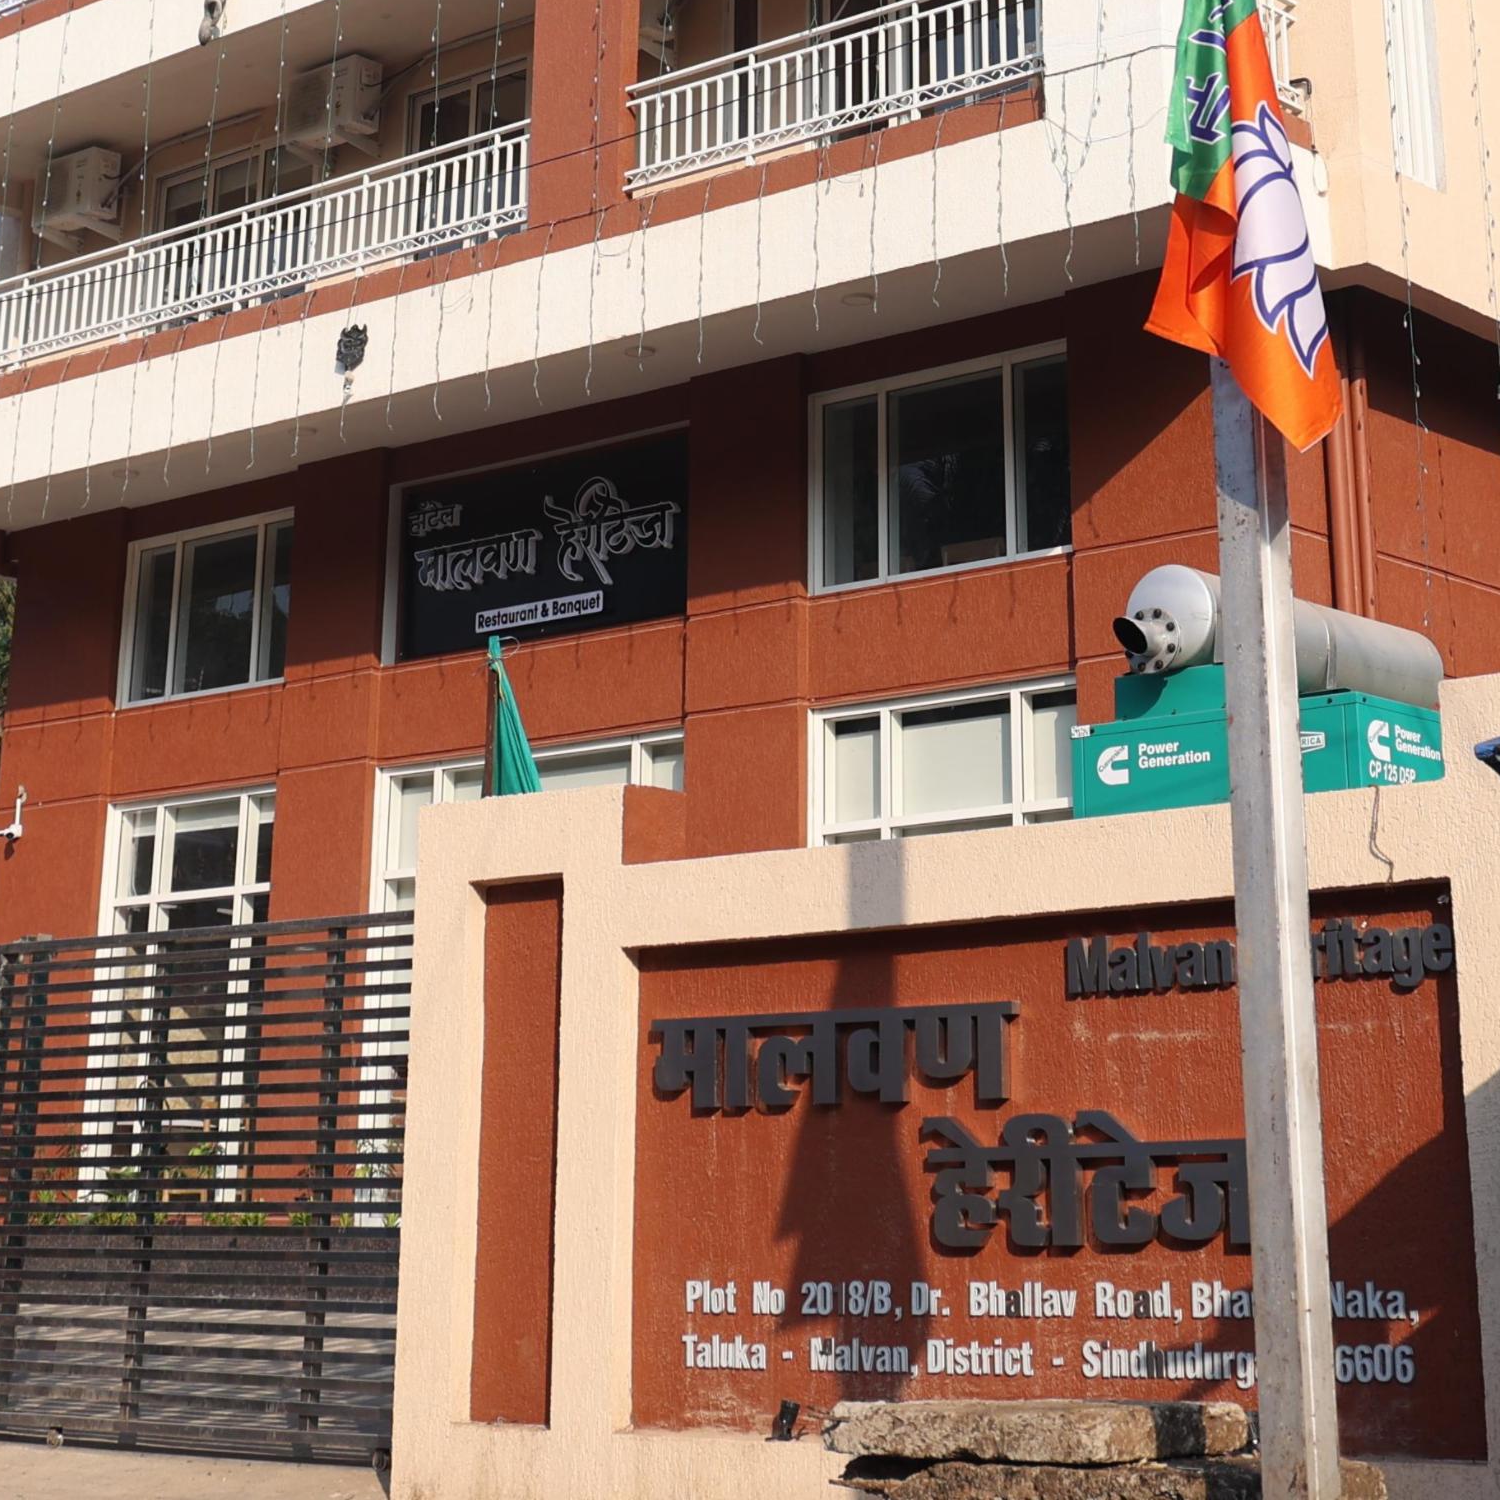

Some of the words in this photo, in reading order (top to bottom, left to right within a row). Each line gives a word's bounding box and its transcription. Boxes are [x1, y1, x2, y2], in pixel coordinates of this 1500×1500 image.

[414, 528, 544, 591] मालवण
[477, 604, 539, 630] Restaurant
[540, 602, 550, 618] &
[552, 593, 601, 619] Banquet
[1138, 741, 1180, 756] Power
[1301, 737, 1322, 746] RICA
[1394, 724, 1421, 743] Power
[1395, 738, 1442, 762] Generation
[1138, 750, 1211, 769] Generation
[1369, 759, 1382, 779] CP
[1383, 763, 1398, 782] 125
[1065, 931, 1236, 1000] Malvan
[1310, 917, 1454, 992] ritage
[648, 1001, 1021, 1114] मालवण
[919, 1109, 1251, 1254] हेरीटेज
[685, 1279, 737, 1316] Plot
[752, 1279, 785, 1316] No
[911, 1281, 950, 1317] Dr.
[969, 1280, 1077, 1318] Bhallav
[1095, 1280, 1183, 1325] Road,
[1191, 1280, 1256, 1319] Bha
[1330, 1280, 1419, 1326] Naka,
[681, 1334, 766, 1372] Taluka
[781, 1350, 793, 1360] -
[809, 1336, 918, 1380] Malvan,
[926, 1337, 1034, 1377] District
[1052, 1356, 1064, 1367] -
[1081, 1339, 1257, 1389] Sindhudurg
[1334, 1343, 1414, 1384] 6606
